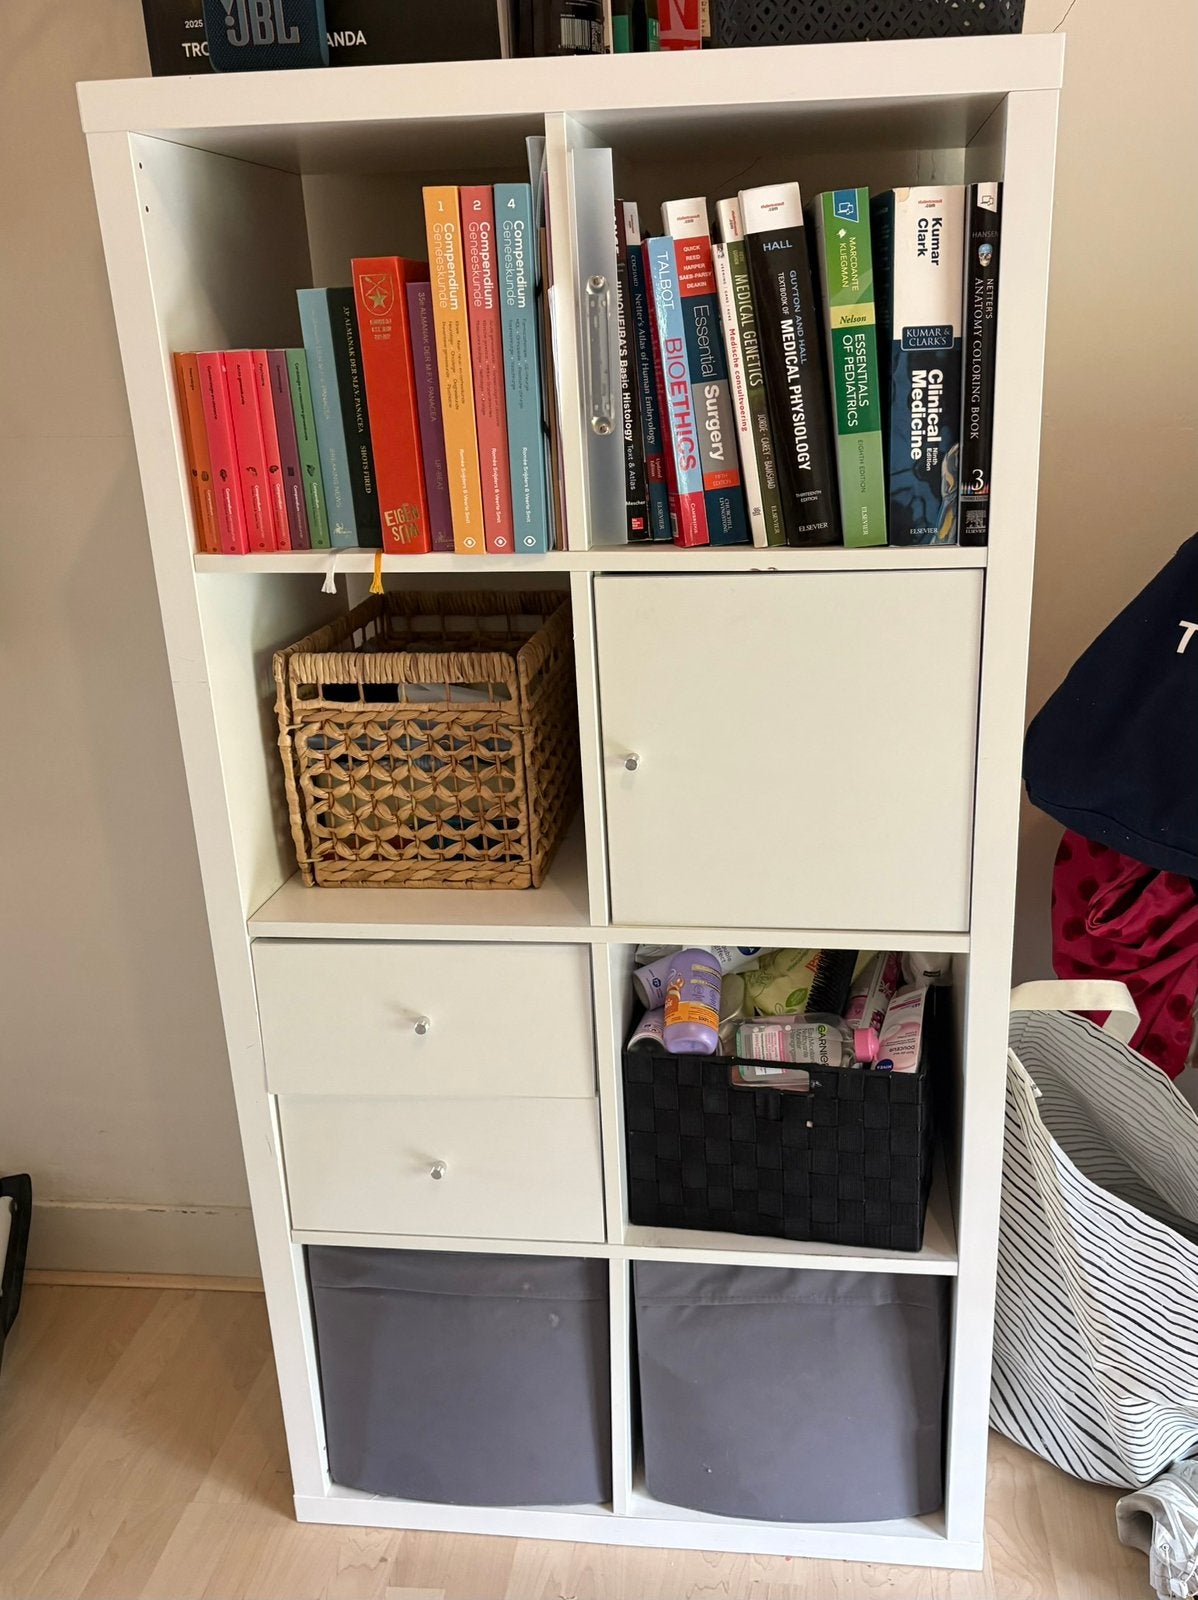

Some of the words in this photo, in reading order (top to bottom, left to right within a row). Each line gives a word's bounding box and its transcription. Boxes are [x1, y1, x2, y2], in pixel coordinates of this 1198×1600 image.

[184, 19, 204, 29] 2025
[226, 0, 300, 47] JBL
[326, 30, 367, 47] ANDA
[437, 200, 444, 212] 1
[472, 199, 482, 211] 2
[507, 198, 516, 209] 4
[762, 239, 793, 252] HALL
[917, 218, 929, 257] Clark
[931, 217, 943, 266] Kumar
[972, 231, 998, 239] HANSEN
[433, 222, 448, 309] Geneeskunde
[443, 222, 459, 310] Compendium
[468, 221, 484, 308] Geneeskunde
[479, 221, 494, 309] Compendium
[502, 220, 516, 306] Geneeskunde
[512, 220, 527, 308] Compendium
[630, 254, 639, 287] COCHARD
[683, 263, 706, 271] HARPER
[839, 242, 849, 288] KLIEGMAN
[848, 237, 860, 292] MARCDANTE
[656, 250, 675, 311] TALBOT
[686, 281, 707, 289] DEAKIN
[777, 271, 788, 305] TEXTBOOK
[789, 269, 801, 313] GUYTON
[634, 292, 645, 327] Netter's
[734, 273, 754, 328] MEDICAL
[781, 305, 790, 316] OF
[972, 277, 984, 337] ANATOMY
[985, 278, 994, 320] NETTER'S
[419, 306, 430, 345] ALMANAK
[795, 315, 804, 337] AND
[839, 315, 867, 325] Nelson
[906, 328, 942, 338] KUMAR
[943, 328, 951, 336] &
[344, 318, 356, 357] ALMANAK
[638, 328, 647, 350] Atlas
[693, 304, 718, 378] Essential
[780, 319, 800, 383] MEDICAL
[799, 339, 808, 365] HALL
[842, 335, 854, 353] OF
[908, 336, 947, 347] CLARK'S
[349, 358, 358, 374] DER
[423, 345, 432, 362] DER
[640, 351, 649, 361] of
[742, 330, 763, 387] GENETICS
[619, 359, 630, 389] Basic
[641, 361, 651, 394] Human
[728, 328, 740, 369] Medische
[734, 370, 748, 433] consultvoering
[854, 333, 870, 407] ESSENTIALS
[970, 340, 983, 403] COLORING
[427, 386, 438, 422] PANACEA
[664, 337, 697, 472] BIOETHICS
[844, 356, 859, 427] PEDIATRICS
[926, 368, 944, 443] Clinical
[354, 397, 364, 433] PANACEA
[622, 391, 634, 442] Histology
[645, 395, 656, 445] Embryology
[704, 384, 725, 461] Surgery
[757, 413, 768, 432] JORDE
[788, 384, 812, 472] PHYSIOLOGY
[910, 369, 927, 460] Medicine
[925, 447, 933, 472] Edition
[969, 406, 980, 439] BOOK
[360, 444, 369, 469] SHOTS
[626, 444, 635, 461] Text
[761, 436, 772, 456] CAREY
[857, 439, 865, 465] EIGHTH
[363, 470, 372, 494] FIRED
[628, 469, 637, 491] Atlas
[764, 459, 776, 490] BAMSHAD
[859, 466, 867, 494] EDITION
[971, 468, 984, 491] 3
[275, 482, 283, 510] Compendium
[312, 482, 320, 509] Compendium
[795, 489, 822, 498] THIRTEENTH
[800, 495, 818, 503] EDITION
[384, 502, 420, 527] EIGEN
[656, 500, 665, 530] ELSEVIER
[719, 496, 728, 534] LIVINGSTONE
[724, 498, 733, 530] CHURCHILL
[771, 505, 780, 535] ELSEVIER
[798, 521, 829, 533] ELSEVIER
[861, 506, 869, 536] ELSEVIER
[909, 527, 938, 535] ELSEVIER
[889, 1044, 916, 1054] DOUCEUR
